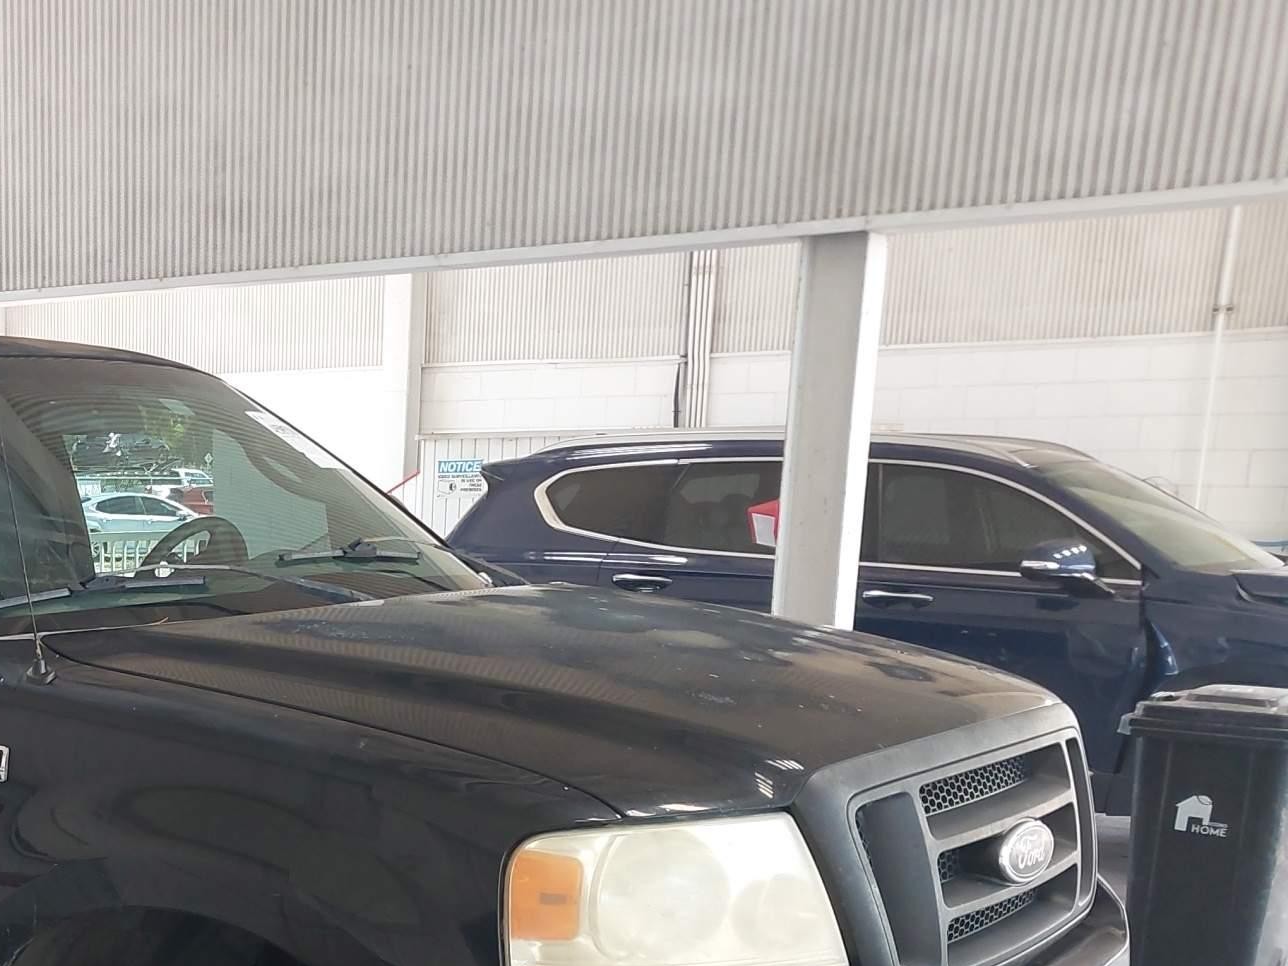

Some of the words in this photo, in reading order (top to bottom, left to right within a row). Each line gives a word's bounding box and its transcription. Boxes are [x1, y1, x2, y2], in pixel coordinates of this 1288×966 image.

[439, 461, 481, 473] NOTICE
[1191, 823, 1229, 838] HOME
[1015, 833, 1046, 870] Ford
